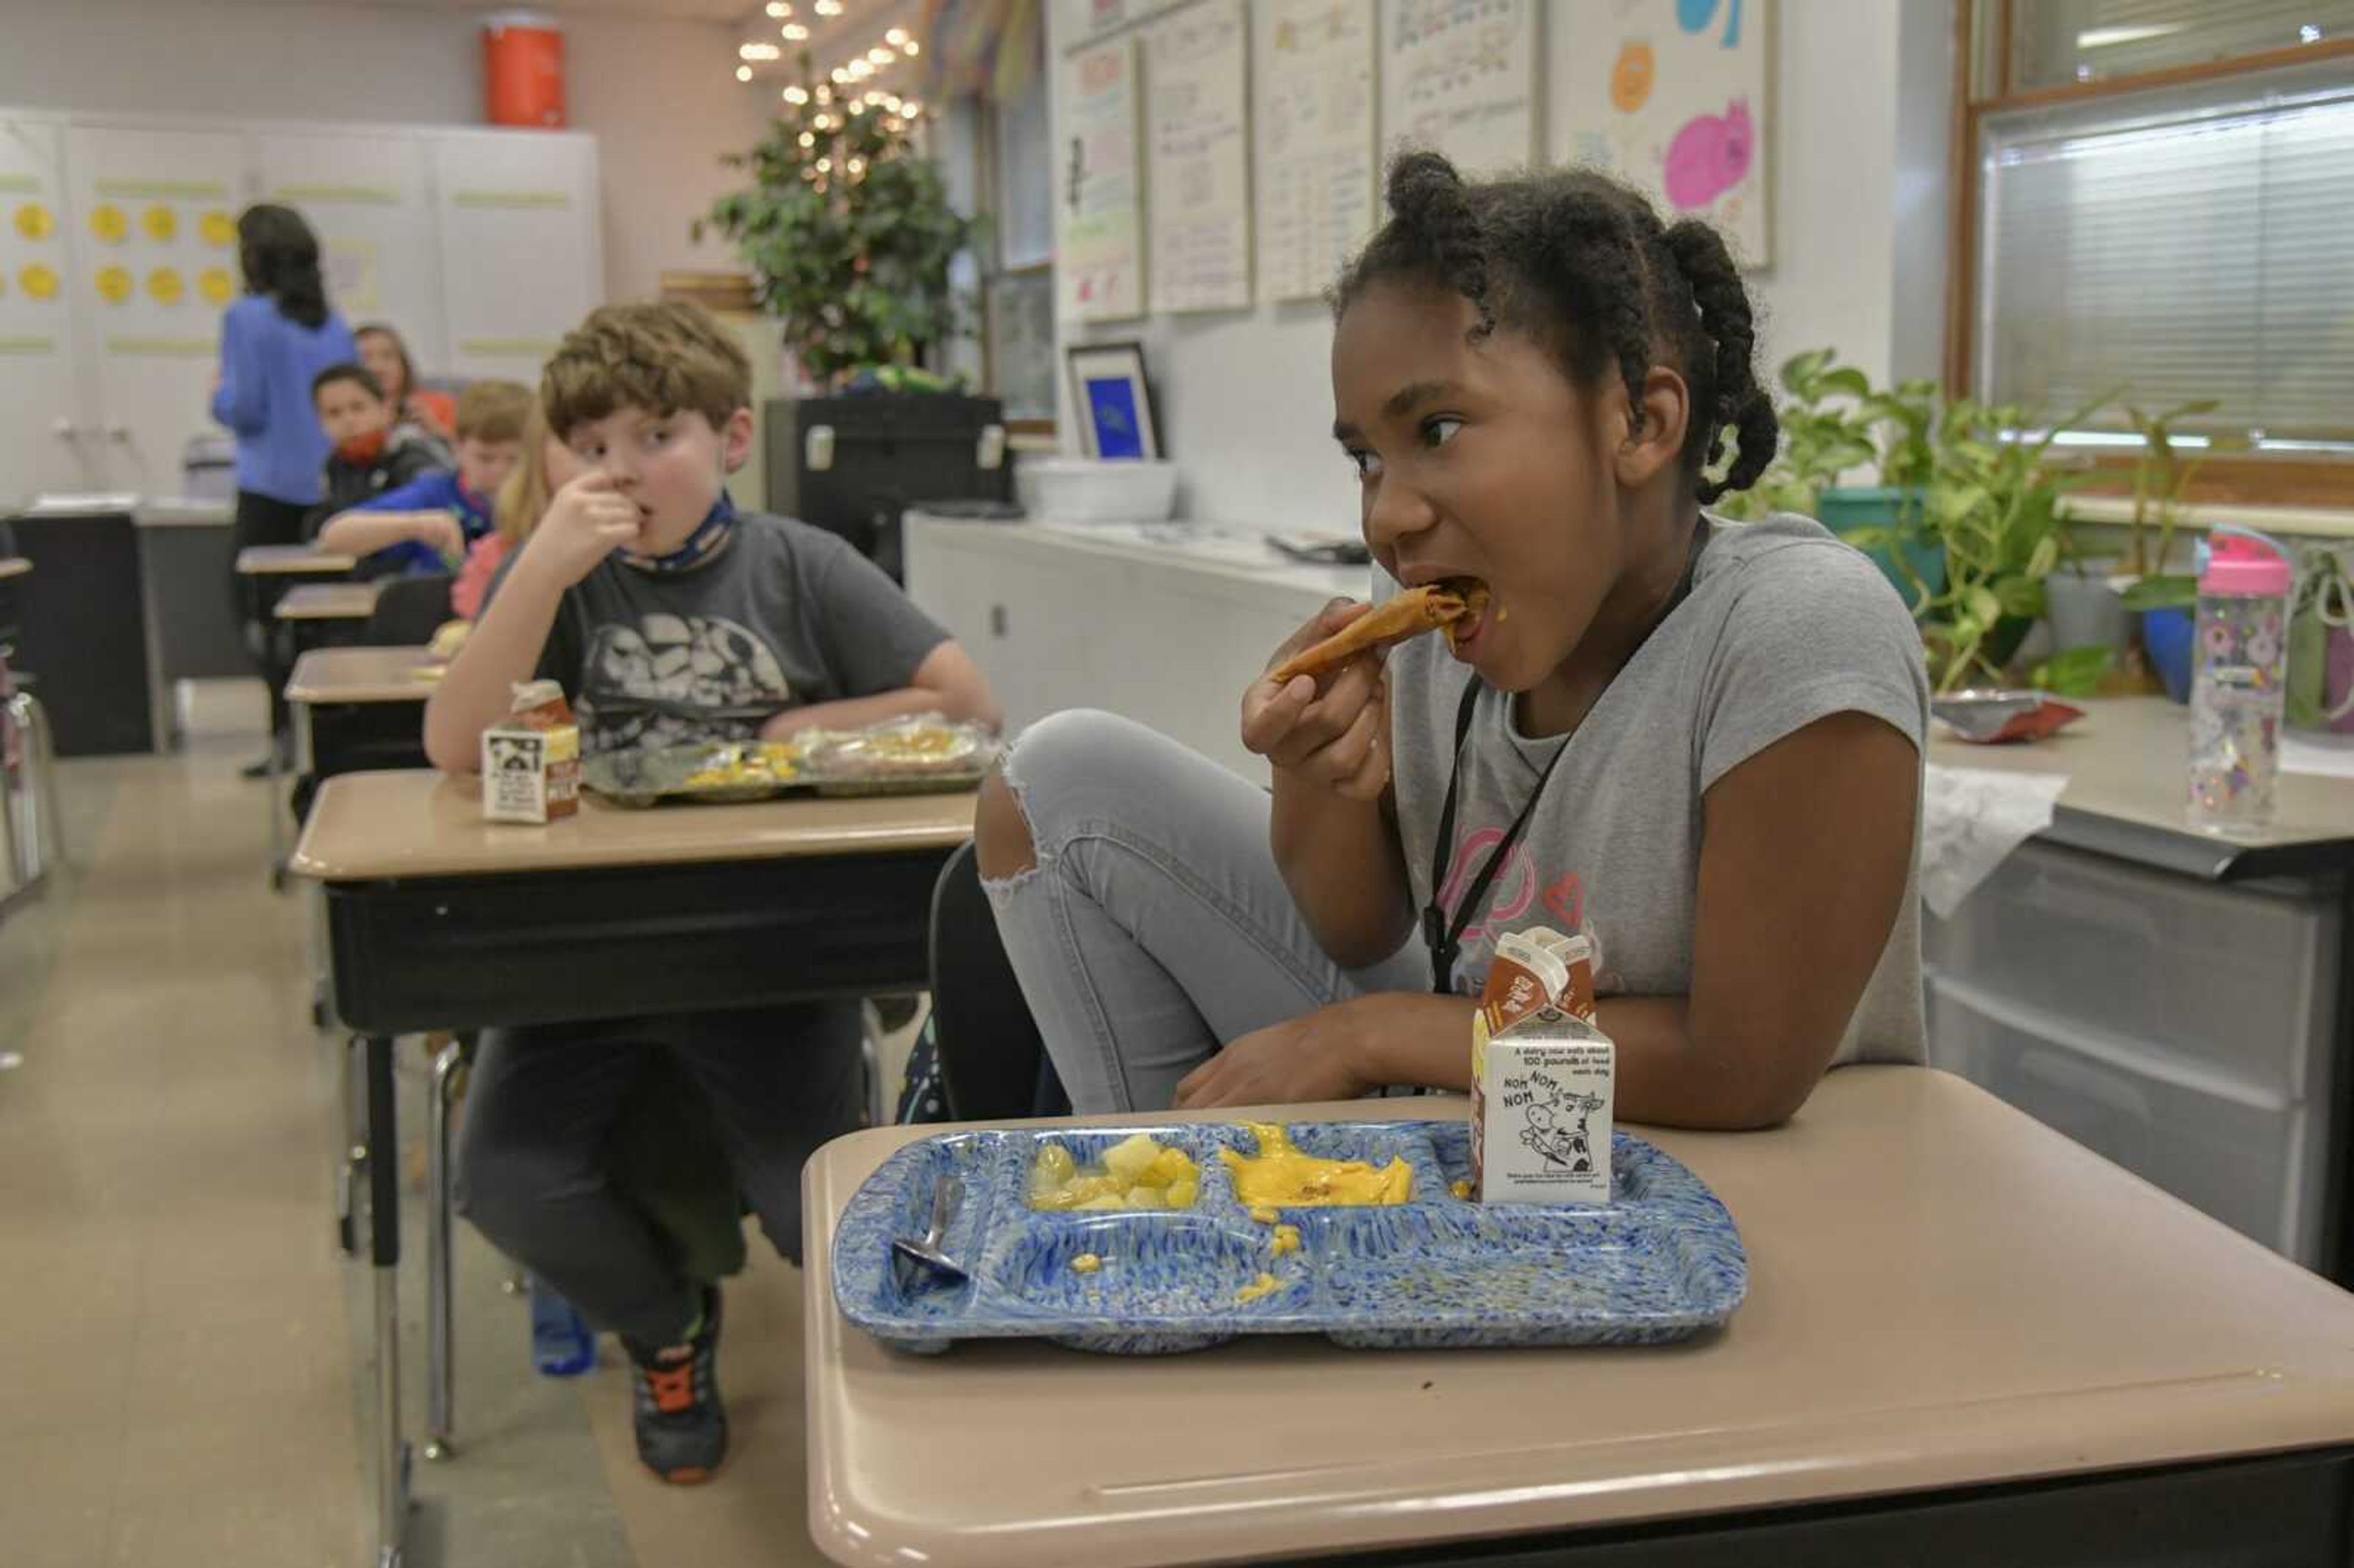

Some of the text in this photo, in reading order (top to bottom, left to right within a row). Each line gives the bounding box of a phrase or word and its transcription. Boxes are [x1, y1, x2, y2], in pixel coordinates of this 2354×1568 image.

[1523, 1047, 1545, 1056] dairy
[1544, 1057, 1579, 1067] pounds
[1504, 1071, 1559, 1090] NOM NOM
[1503, 1090, 1534, 1107] NOM
